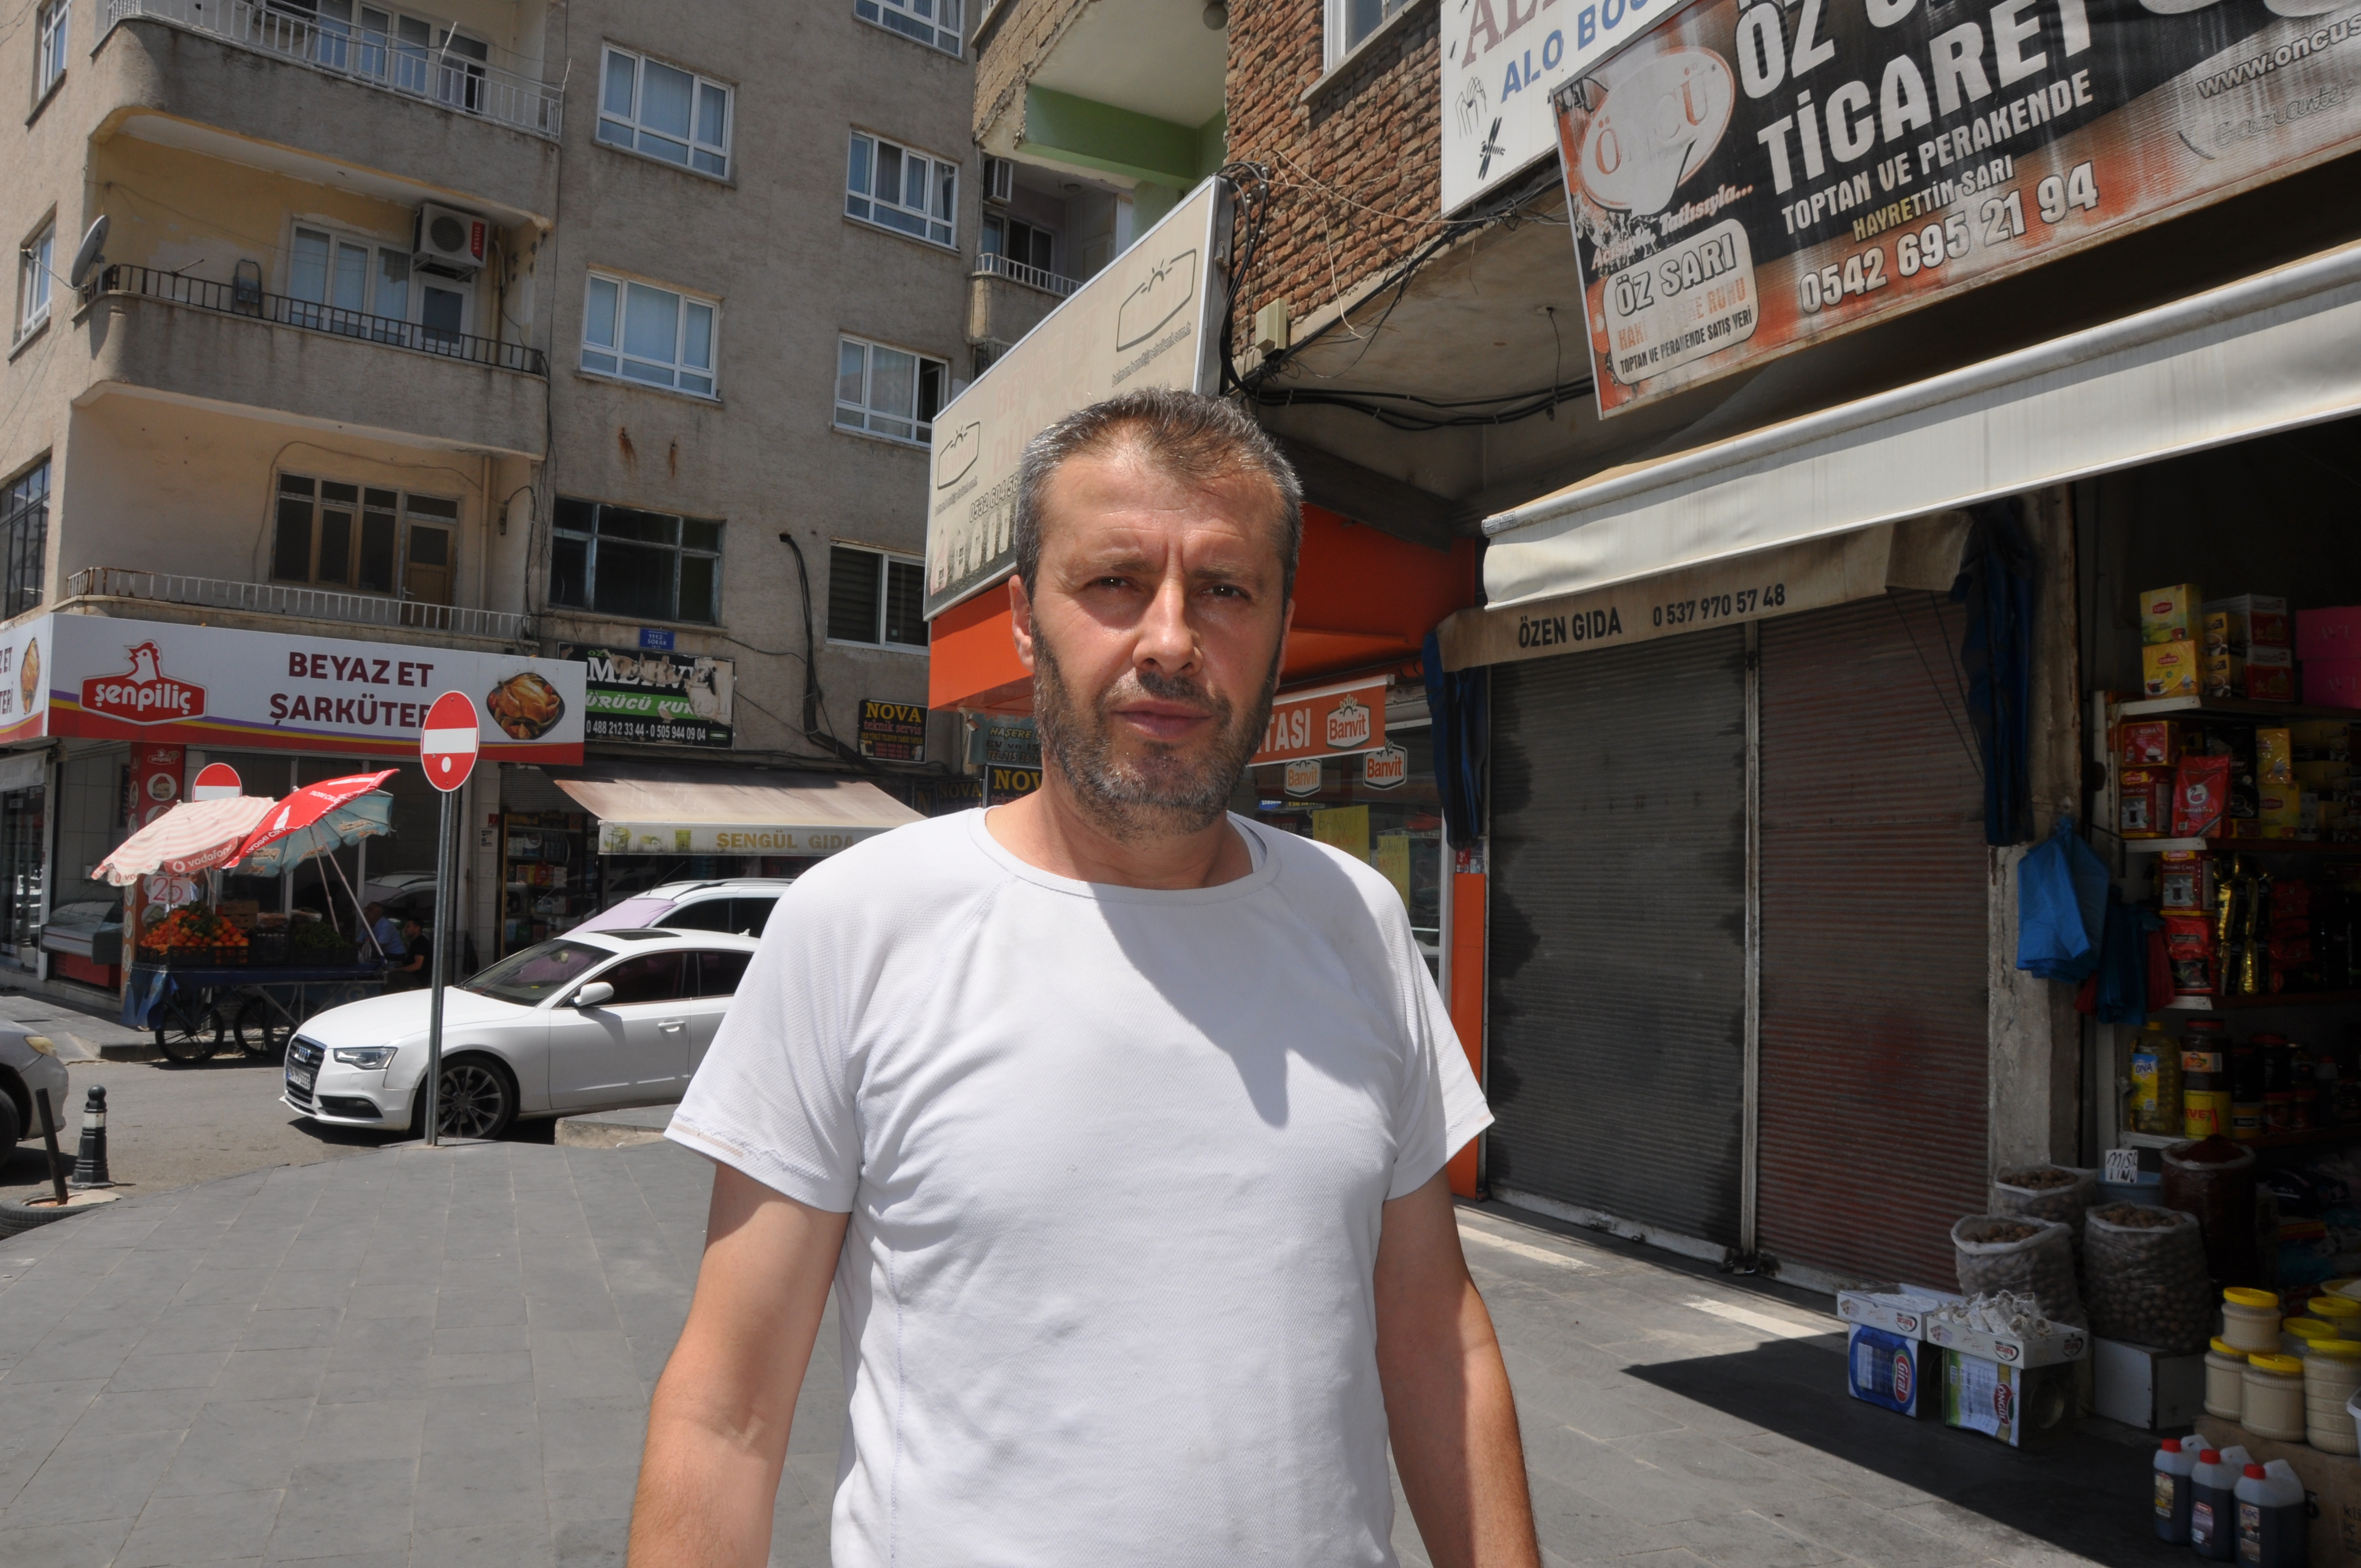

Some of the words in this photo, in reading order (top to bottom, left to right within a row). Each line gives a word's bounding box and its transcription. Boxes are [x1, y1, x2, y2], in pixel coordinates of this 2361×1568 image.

[1501, 30, 1564, 104] ALO
[1758, 0, 2091, 195] TİCARET
[1781, 170, 1871, 235] TOPTAN
[1876, 152, 1913, 192] VE
[1918, 69, 2093, 176] PERAKENDE
[1852, 177, 1955, 243] HAYRETTİN
[1960, 155, 2015, 197] SARI
[1799, 246, 1888, 316] 0542
[1896, 211, 1970, 278] 695
[1980, 187, 2027, 247] 21
[2036, 161, 2099, 225] 94
[1615, 271, 1654, 317] ÖZ
[1659, 232, 1737, 297] SARI
[1620, 351, 1648, 374] TOPTAN
[1651, 347, 1659, 363] VE
[1660, 328, 1705, 359] PERAKENDE
[1707, 318, 1731, 340] SATIŞ
[1732, 305, 1753, 329] YERİ
[969, 492, 989, 522] 0532
[991, 480, 1006, 508] 604
[1518, 616, 1567, 649] ÖZEN
[1573, 607, 1623, 641] GIDA
[1653, 606, 1662, 627] 0
[1666, 602, 1696, 625] 537
[1701, 594, 1732, 619] 970
[1736, 589, 1758, 613] 57
[1763, 583, 1786, 607] 48
[289, 651, 390, 684] BEYAZ
[398, 661, 434, 688] ET
[94, 683, 192, 715] şenpiliç
[269, 693, 431, 728] ŞARKÜTER
[586, 692, 652, 711] ÜRÜCÜ
[866, 703, 922, 723] NOVA
[586, 722, 591, 736] 0
[593, 723, 607, 737] 488
[608, 724, 622, 738] 212
[624, 725, 633, 739] 33
[635, 726, 644, 740] 44
[650, 727, 655, 741] 0
[657, 727, 670, 742] 505
[672, 728, 685, 742] 944
[687, 729, 694, 743] 09
[697, 731, 706, 744] 04
[863, 719, 894, 732] teknik
[895, 723, 922, 736] servis
[989, 726, 1032, 740] HAŞERE
[1256, 708, 1312, 754] TASI
[1329, 715, 1367, 741] Banvit
[986, 740, 1003, 748] EV
[987, 750, 1018, 761] TEL:215
[993, 769, 1042, 792] NOV
[1287, 768, 1318, 787] Banvit
[1367, 757, 1403, 779] Banvit
[188, 843, 233, 868] vodafon
[716, 830, 798, 852] ŞENGÜL
[808, 835, 855, 850] GIDA
[2135, 1063, 2153, 1073] ONA
[1897, 1361, 1911, 1398] Giral
[1996, 1383, 2010, 1425] ÖNGÜL
